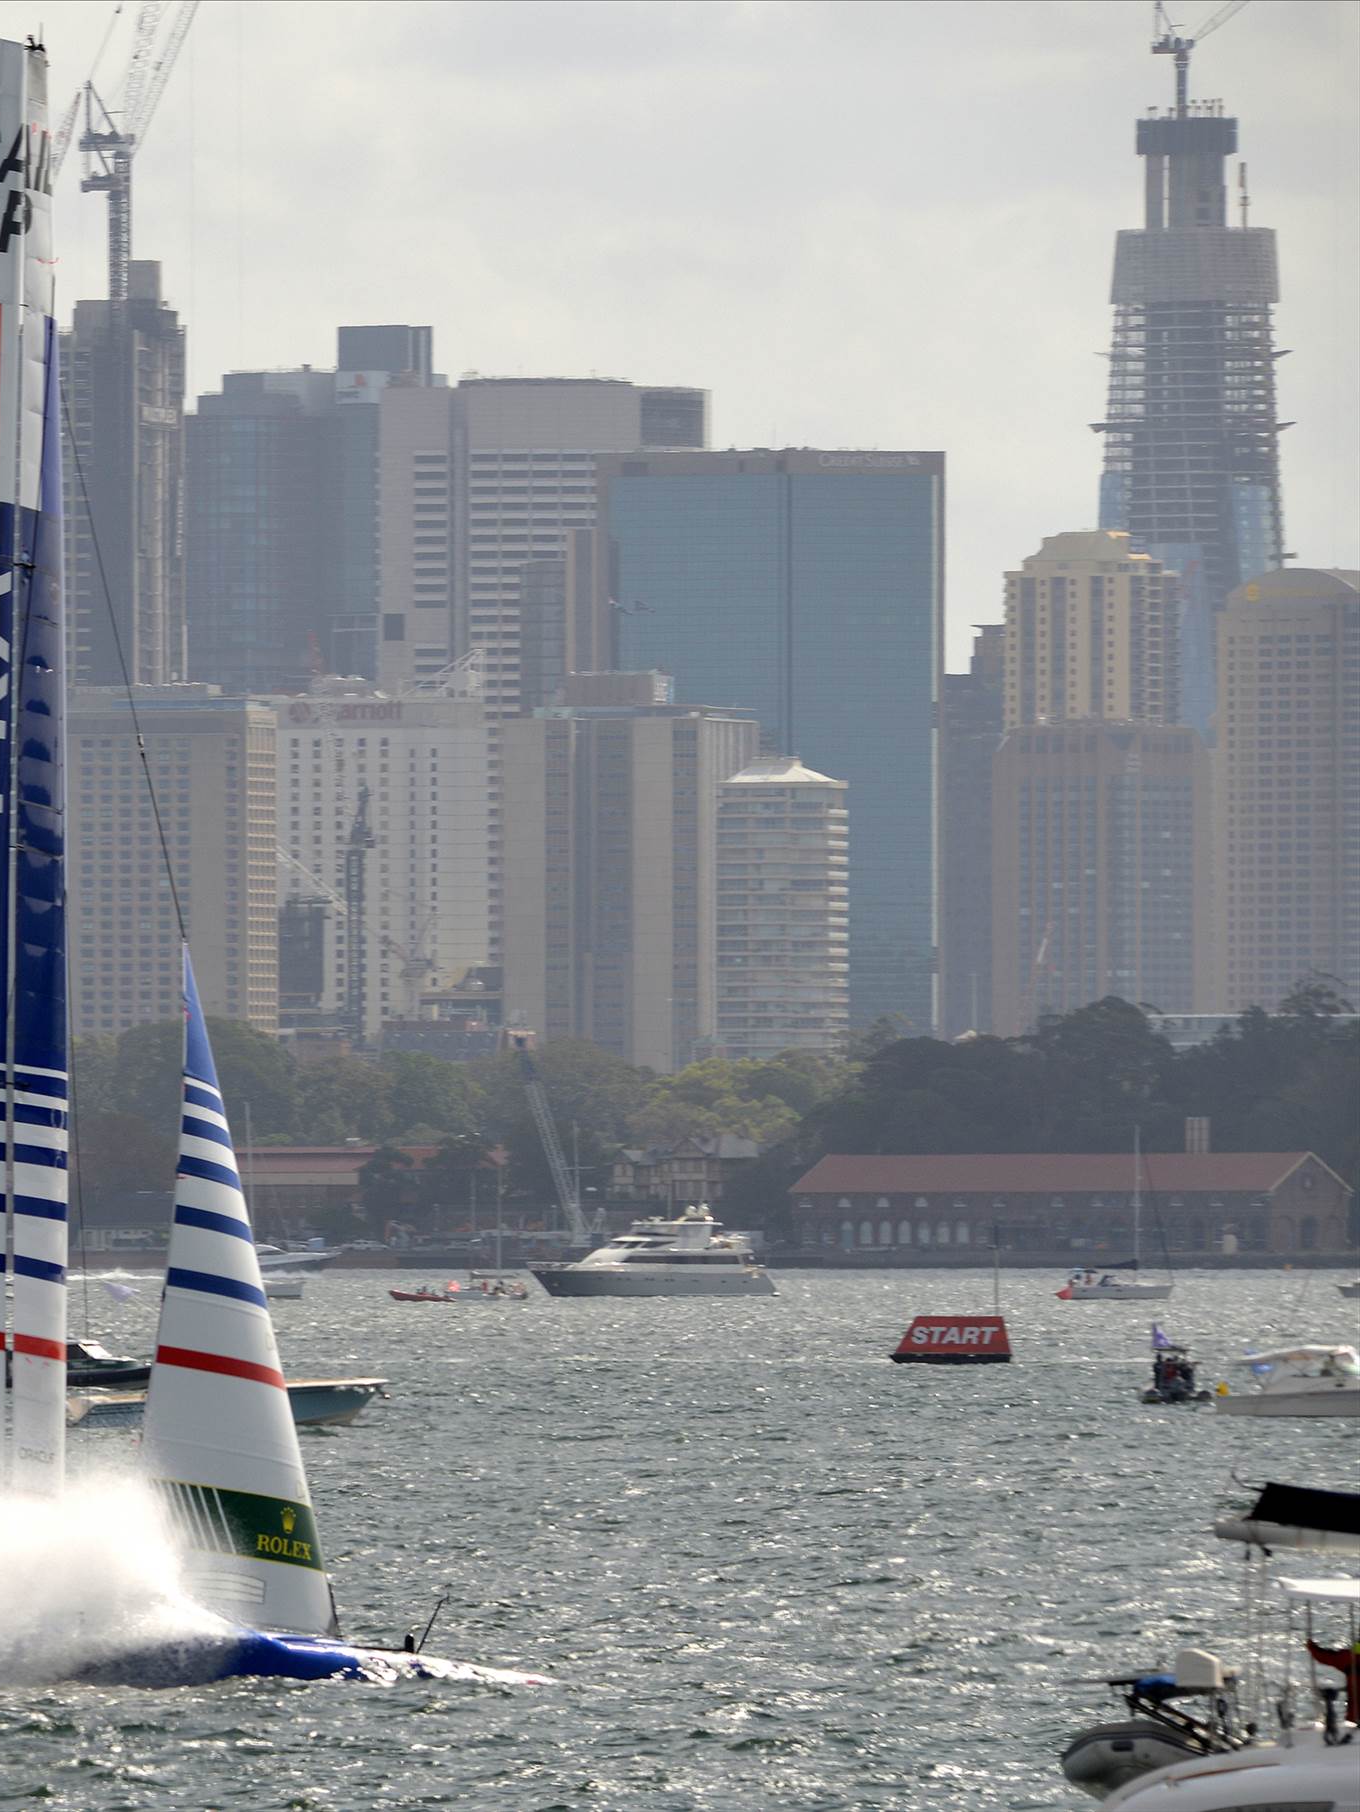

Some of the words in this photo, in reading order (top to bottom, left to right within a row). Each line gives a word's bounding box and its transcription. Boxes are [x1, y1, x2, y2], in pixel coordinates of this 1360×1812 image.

[312, 702, 402, 721] arriott
[910, 1326, 999, 1345] START
[256, 1533, 313, 1561] ROLEX
